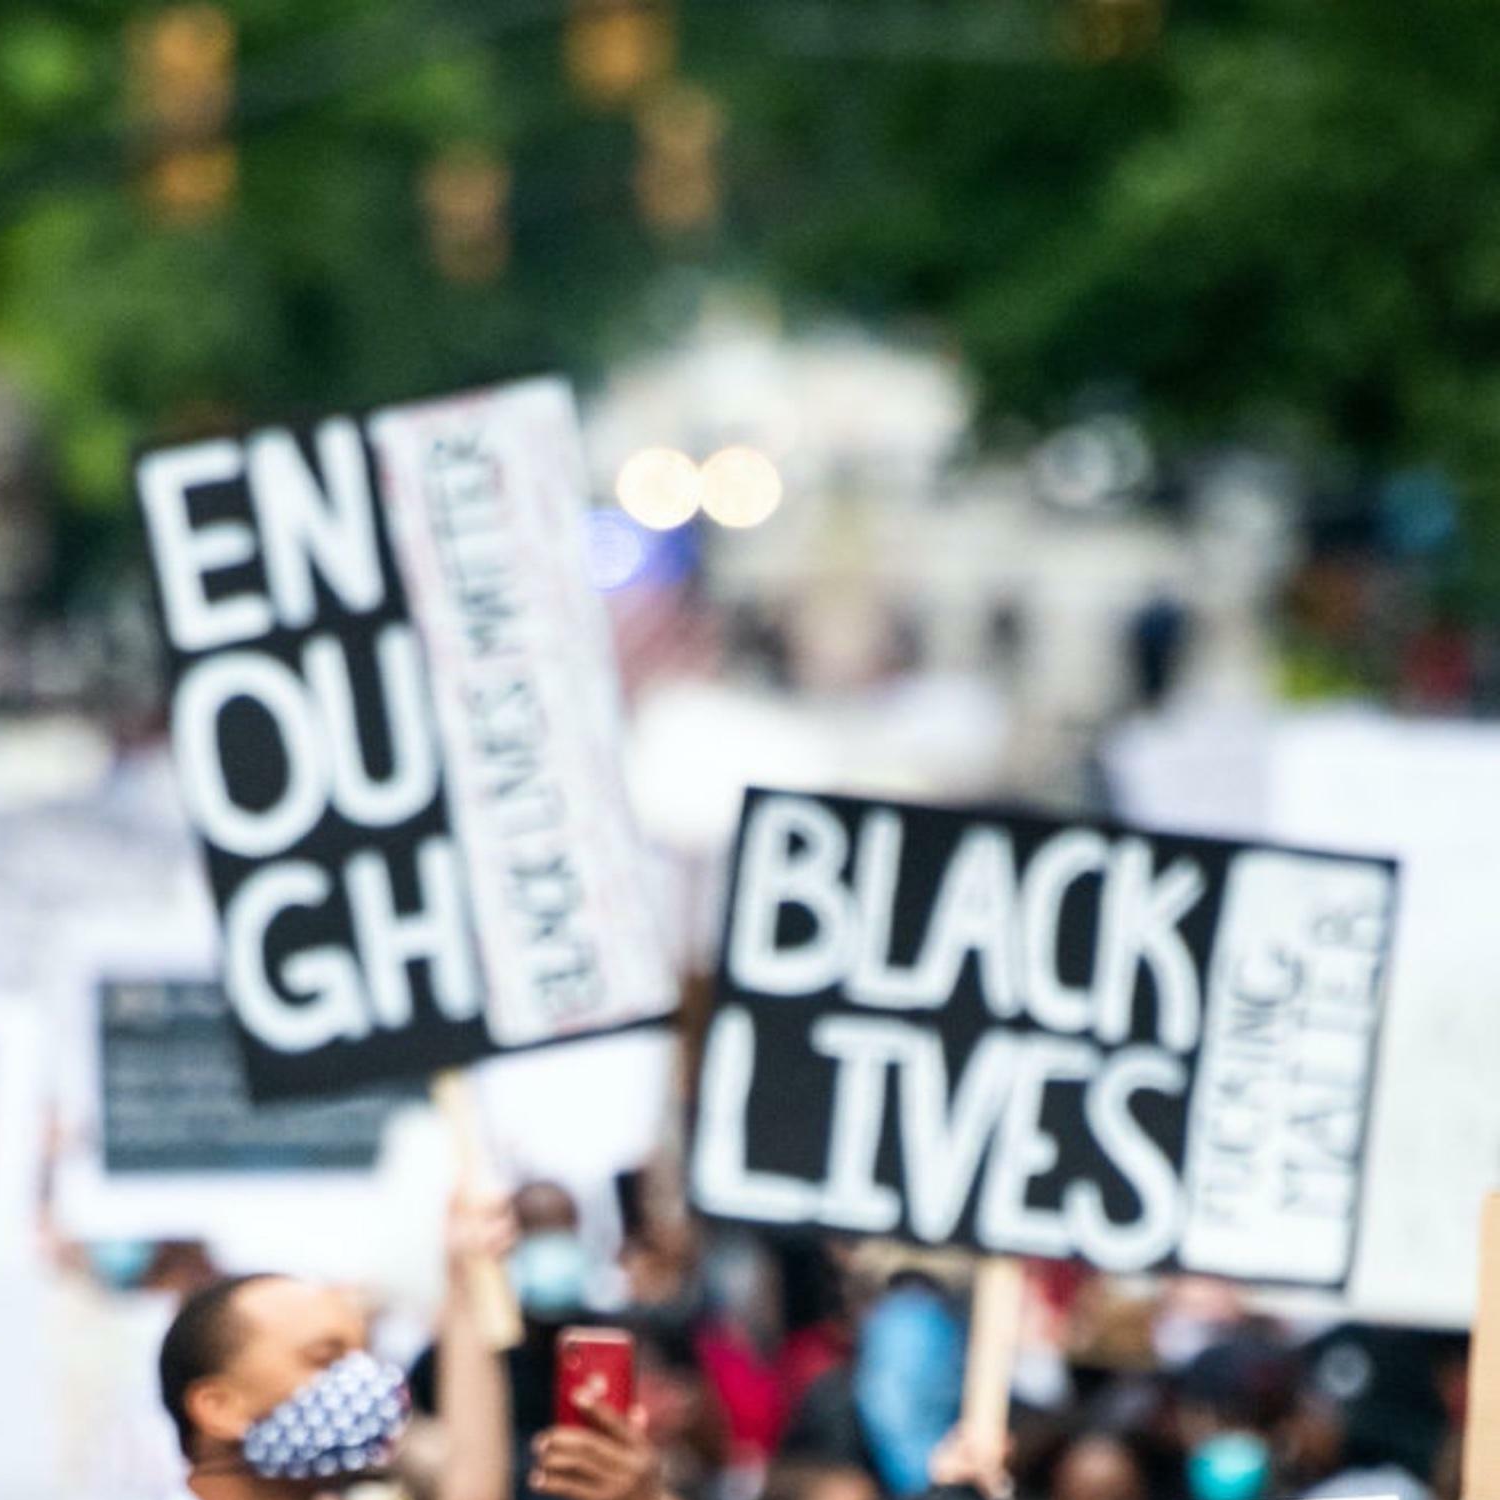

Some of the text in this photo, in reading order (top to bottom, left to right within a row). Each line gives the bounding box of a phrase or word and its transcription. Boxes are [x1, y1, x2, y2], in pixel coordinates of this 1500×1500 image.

[137, 411, 386, 653] EN
[170, 621, 441, 858] OU
[222, 836, 485, 1054] GH
[726, 796, 1206, 1054] BLACK
[691, 1006, 1186, 1271] LIVES
